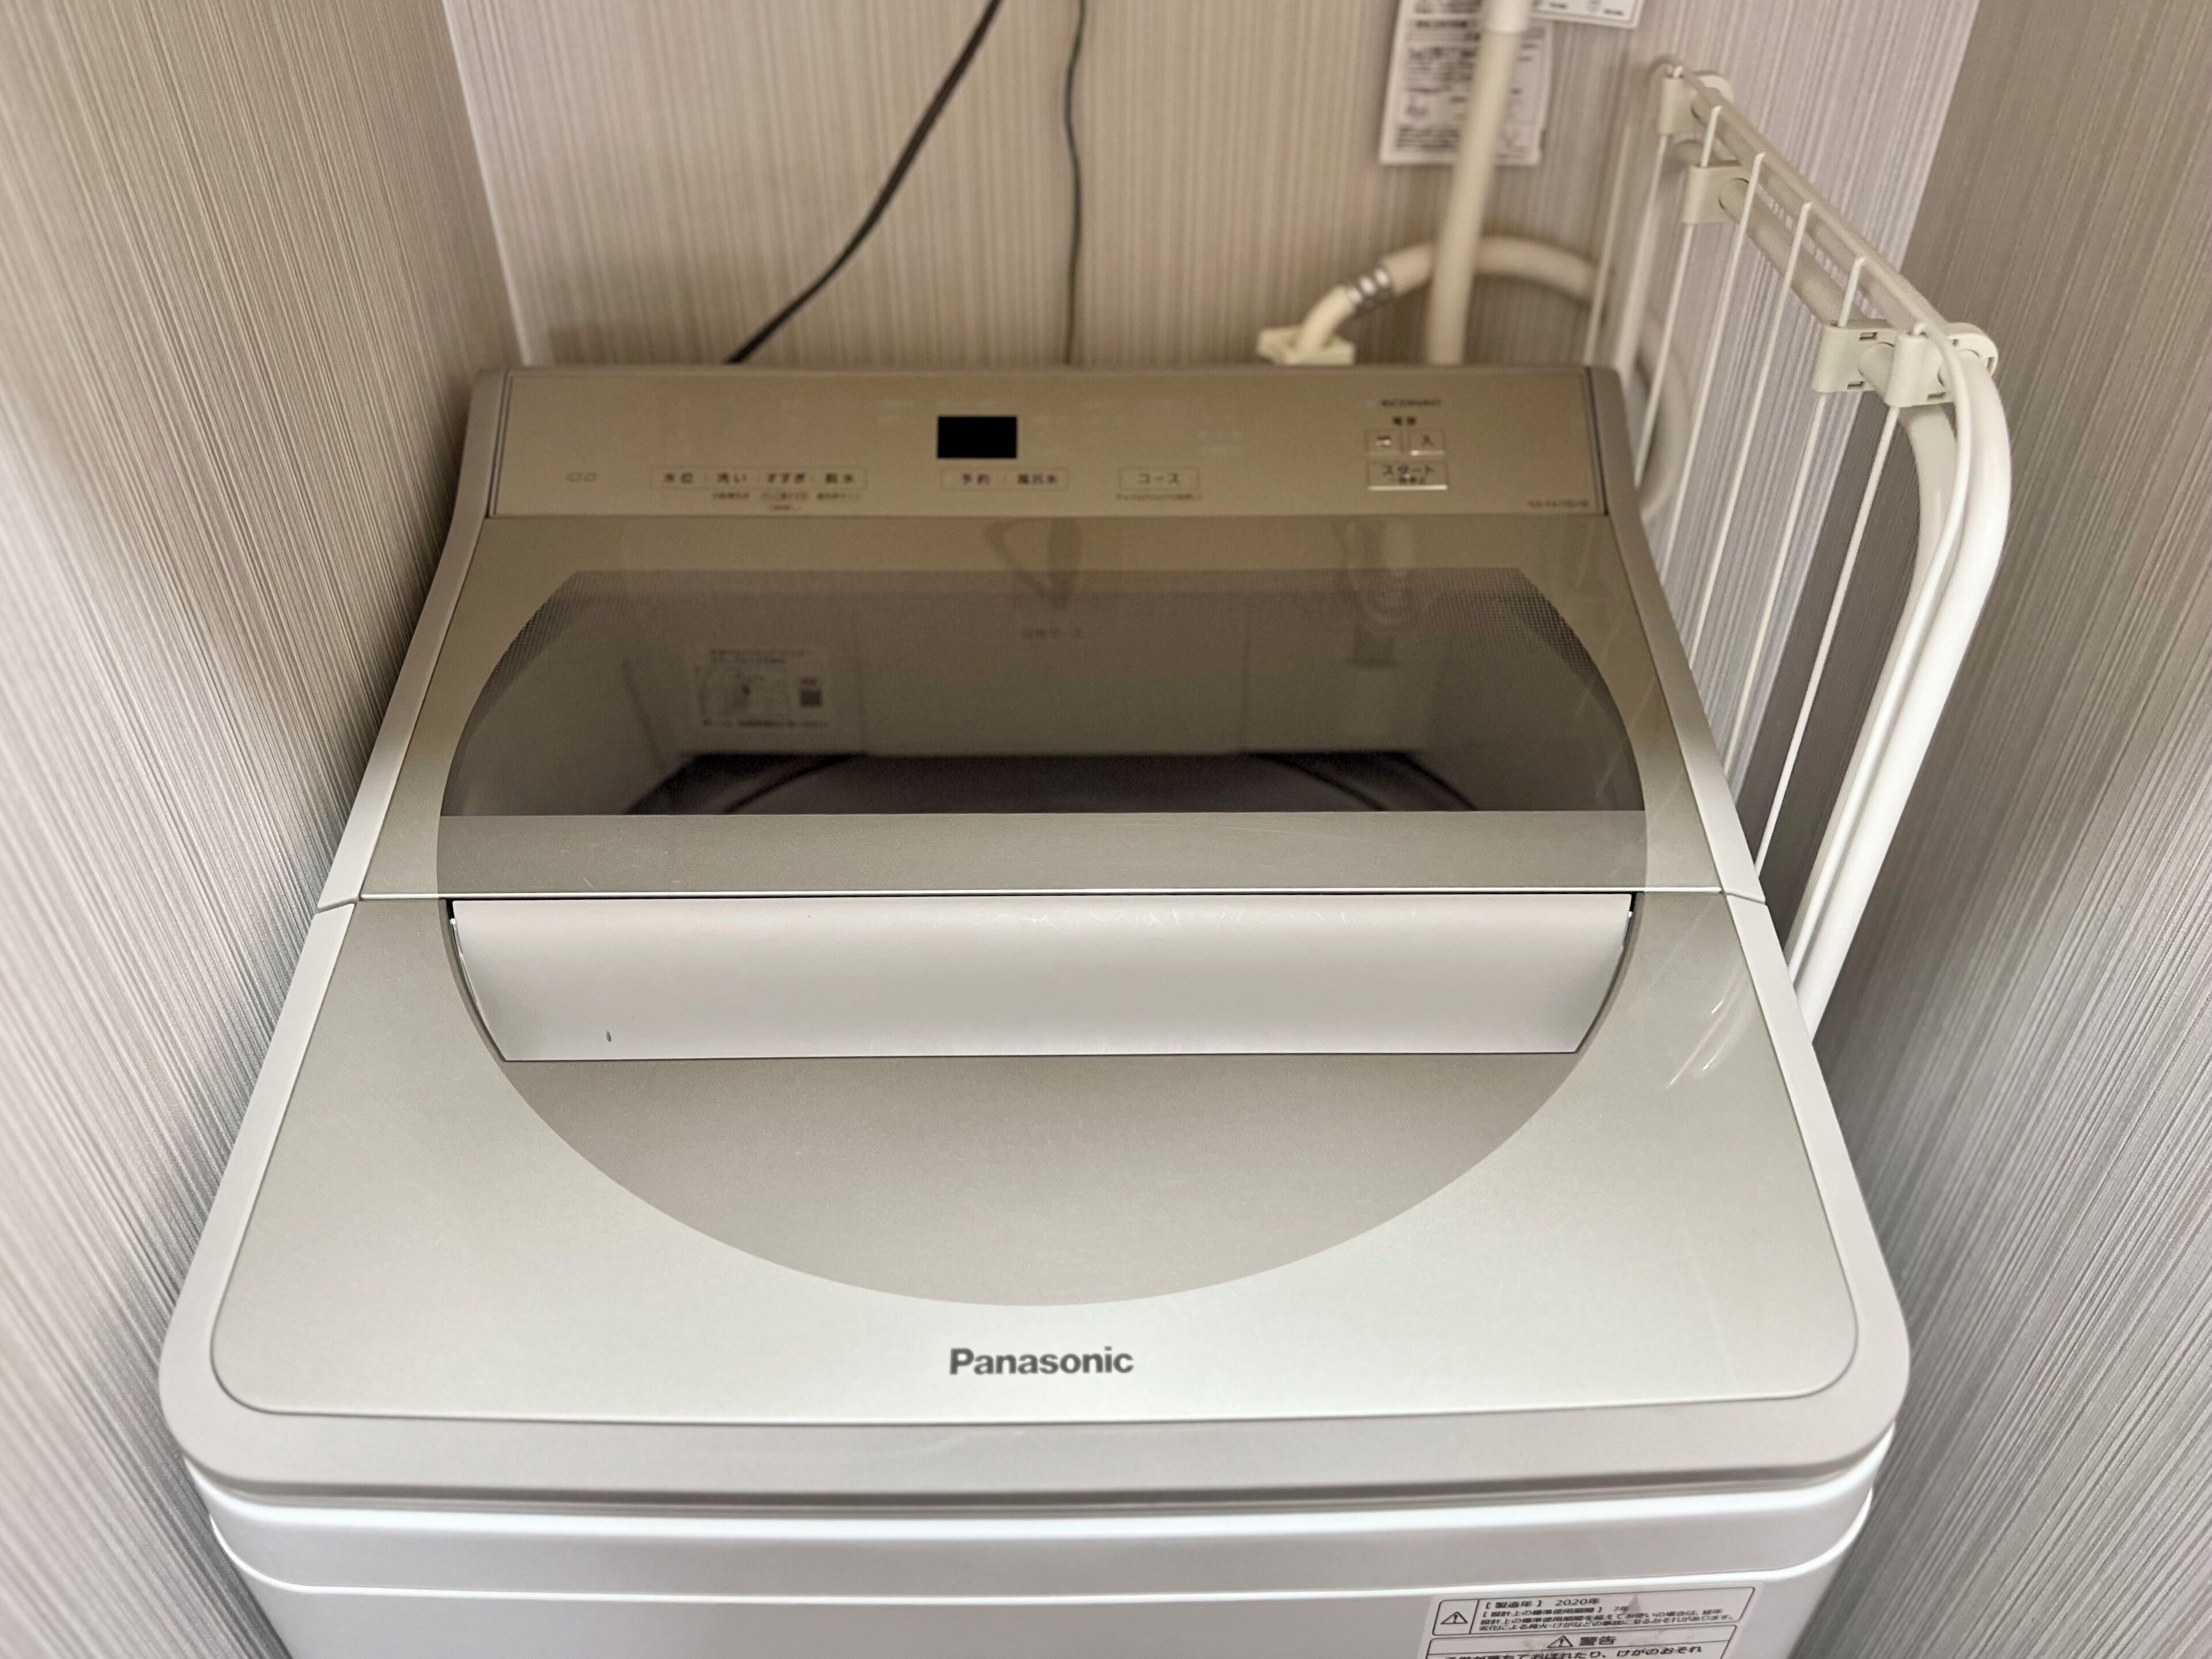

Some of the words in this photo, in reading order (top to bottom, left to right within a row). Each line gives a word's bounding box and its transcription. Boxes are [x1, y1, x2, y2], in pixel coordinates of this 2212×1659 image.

[1138, 472, 1180, 484] コース
[950, 1346, 1134, 1374] Panasonic
[1555, 1597, 1600, 1606] 2020年
[1580, 1635, 1616, 1646] 警告
